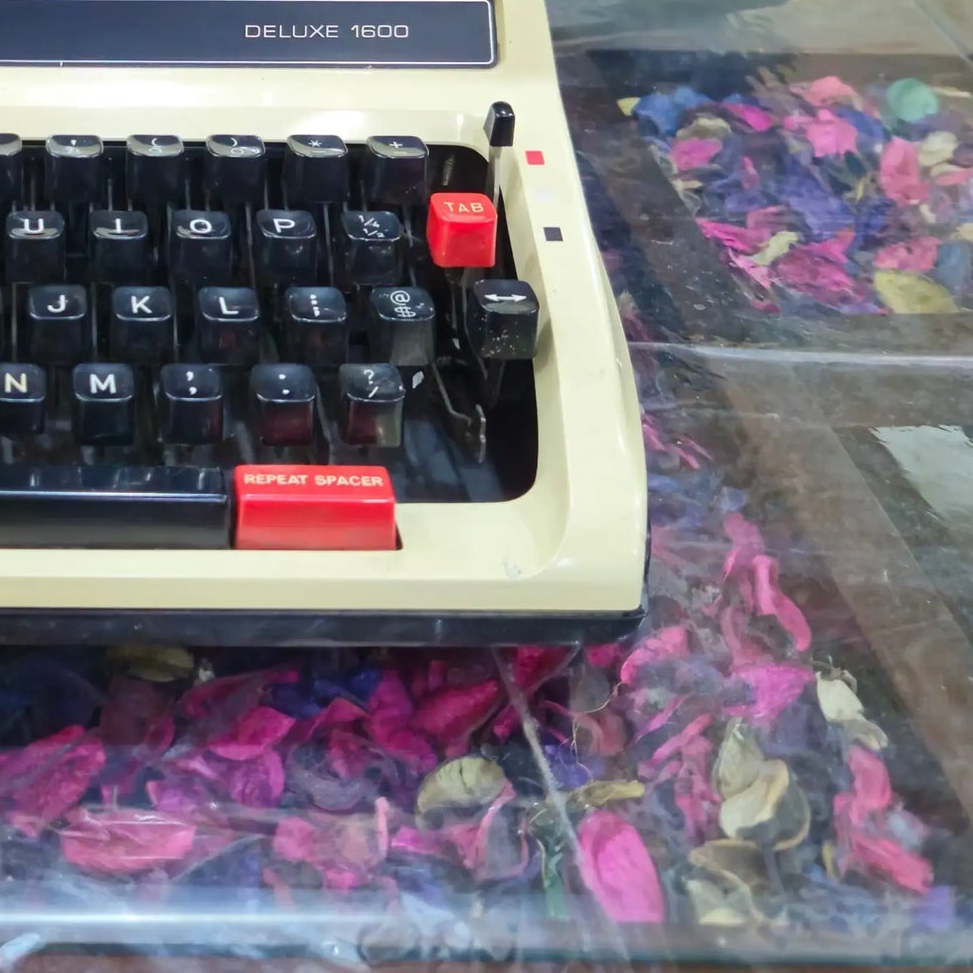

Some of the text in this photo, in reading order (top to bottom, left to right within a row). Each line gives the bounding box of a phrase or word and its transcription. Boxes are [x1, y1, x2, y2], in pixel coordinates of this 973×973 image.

[244, 24, 409, 38] DELUXE 1600
[443, 201, 484, 213] TAB
[23, 218, 44, 234] U
[189, 219, 212, 234] O
[273, 218, 296, 233] P
[47, 294, 66, 313] J
[130, 295, 153, 315] K
[218, 296, 239, 315] L
[390, 290, 411, 306] @
[394, 306, 416, 318] $
[4, 372, 28, 394] N
[89, 373, 117, 394] M
[363, 369, 375, 385] ?
[243, 473, 384, 487] REPEAT SPACER
